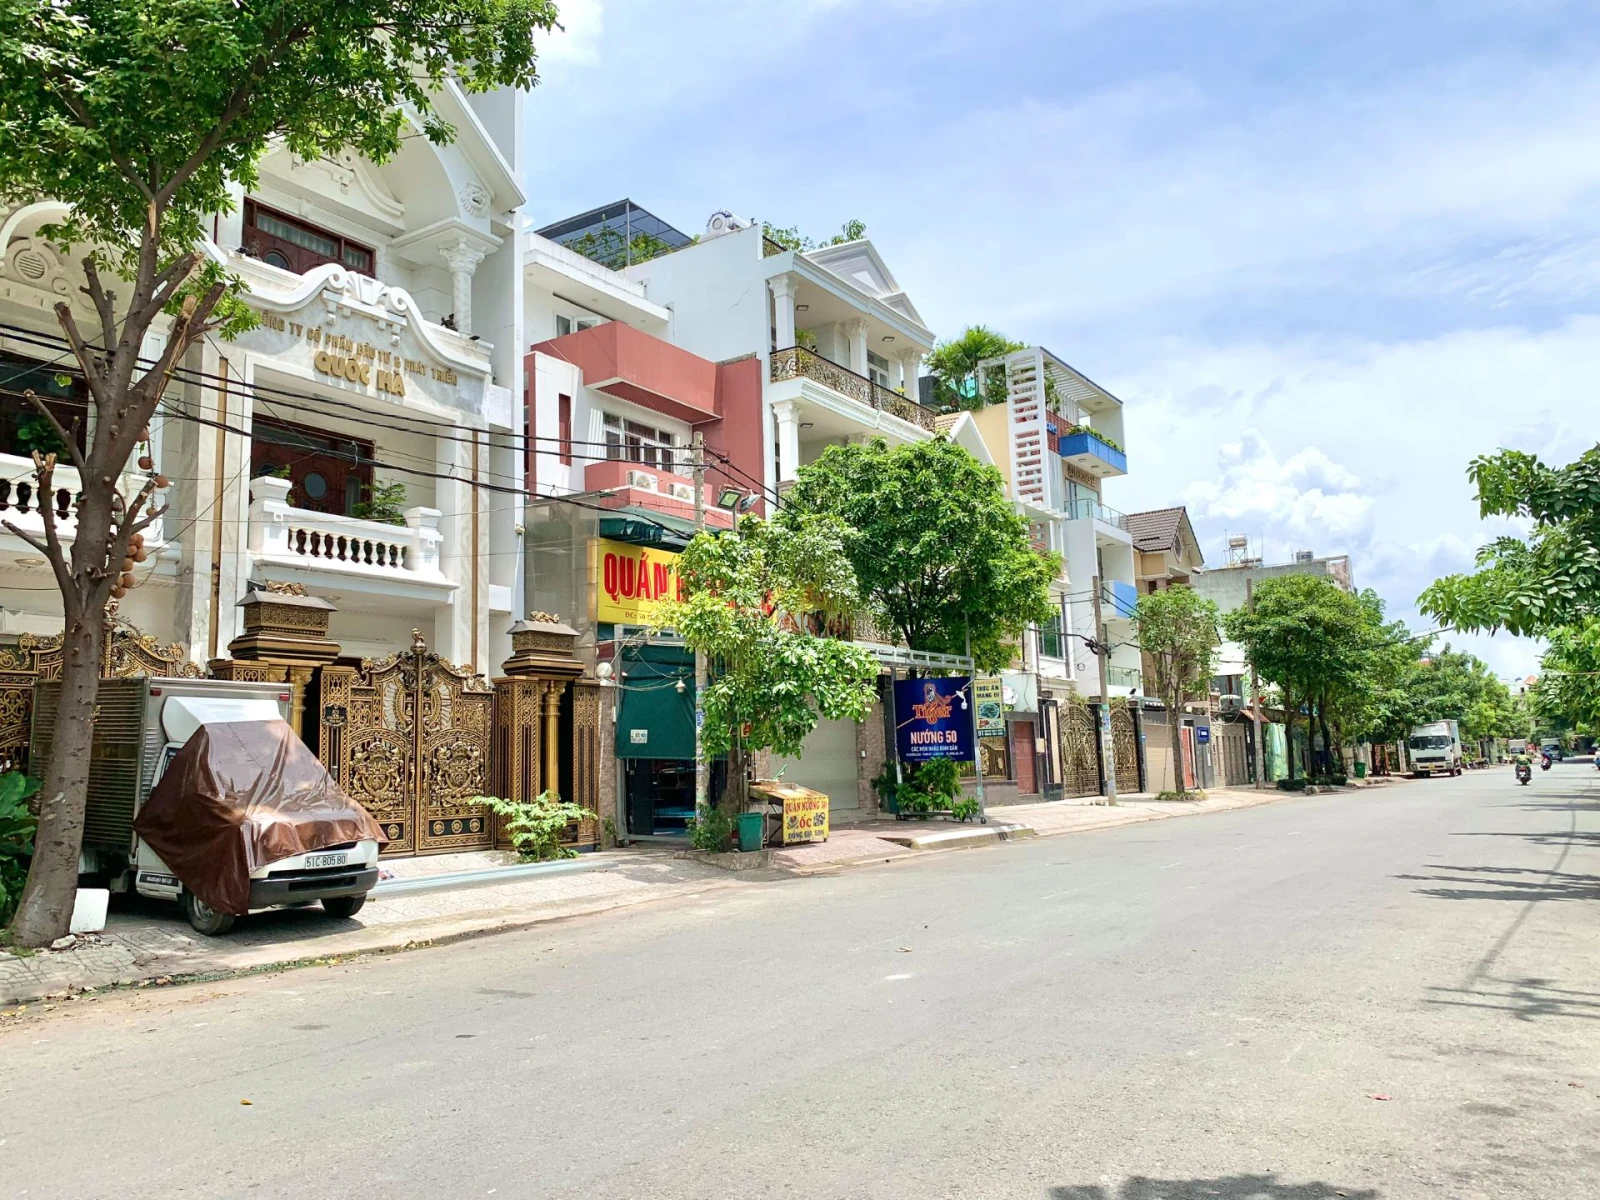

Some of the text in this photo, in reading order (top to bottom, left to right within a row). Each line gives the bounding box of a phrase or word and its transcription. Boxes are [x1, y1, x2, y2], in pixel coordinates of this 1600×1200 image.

[262, 310, 285, 331] ÔNG
[289, 321, 303, 337] TY
[307, 325, 321, 342] CỔ
[404, 358, 426, 376] PHÁT
[314, 350, 406, 397] QUỐC HÀ
[604, 551, 669, 604] QUÁN
[912, 703, 952, 724] Tiger
[910, 729, 958, 744] NƯỚNG 50
[799, 813, 812, 828] ỐC
